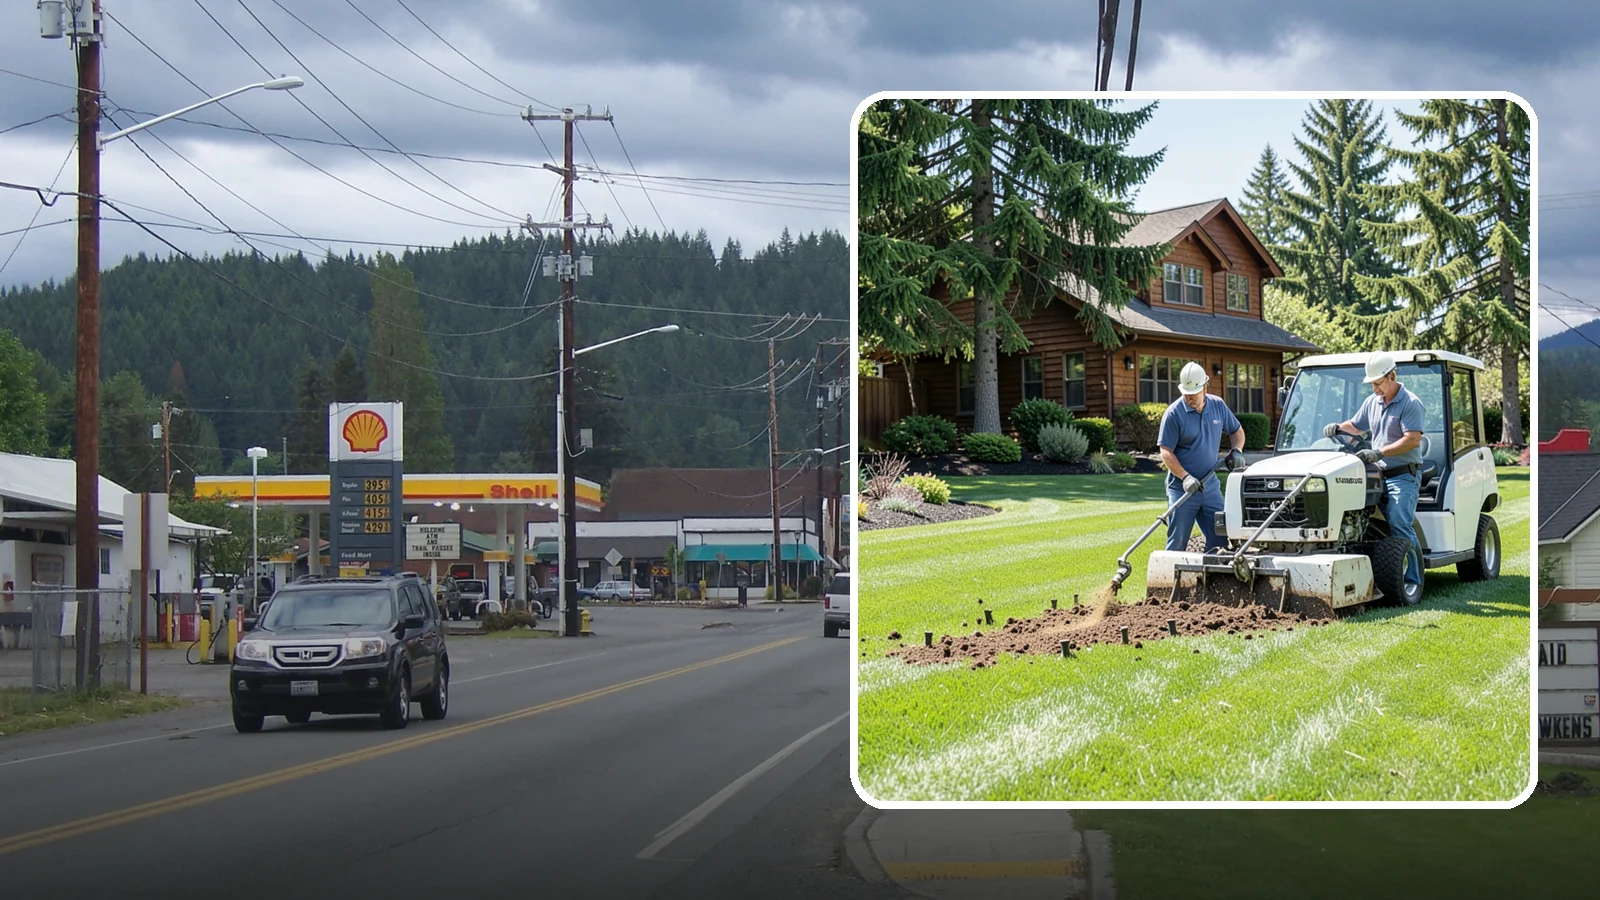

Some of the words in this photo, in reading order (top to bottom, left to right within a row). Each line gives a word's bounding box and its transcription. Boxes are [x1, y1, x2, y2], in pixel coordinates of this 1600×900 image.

[366, 480, 384, 490] 395
[490, 484, 547, 499] Shell
[366, 494, 384, 504] 405
[366, 508, 384, 518] 415
[366, 522, 384, 533] 429
